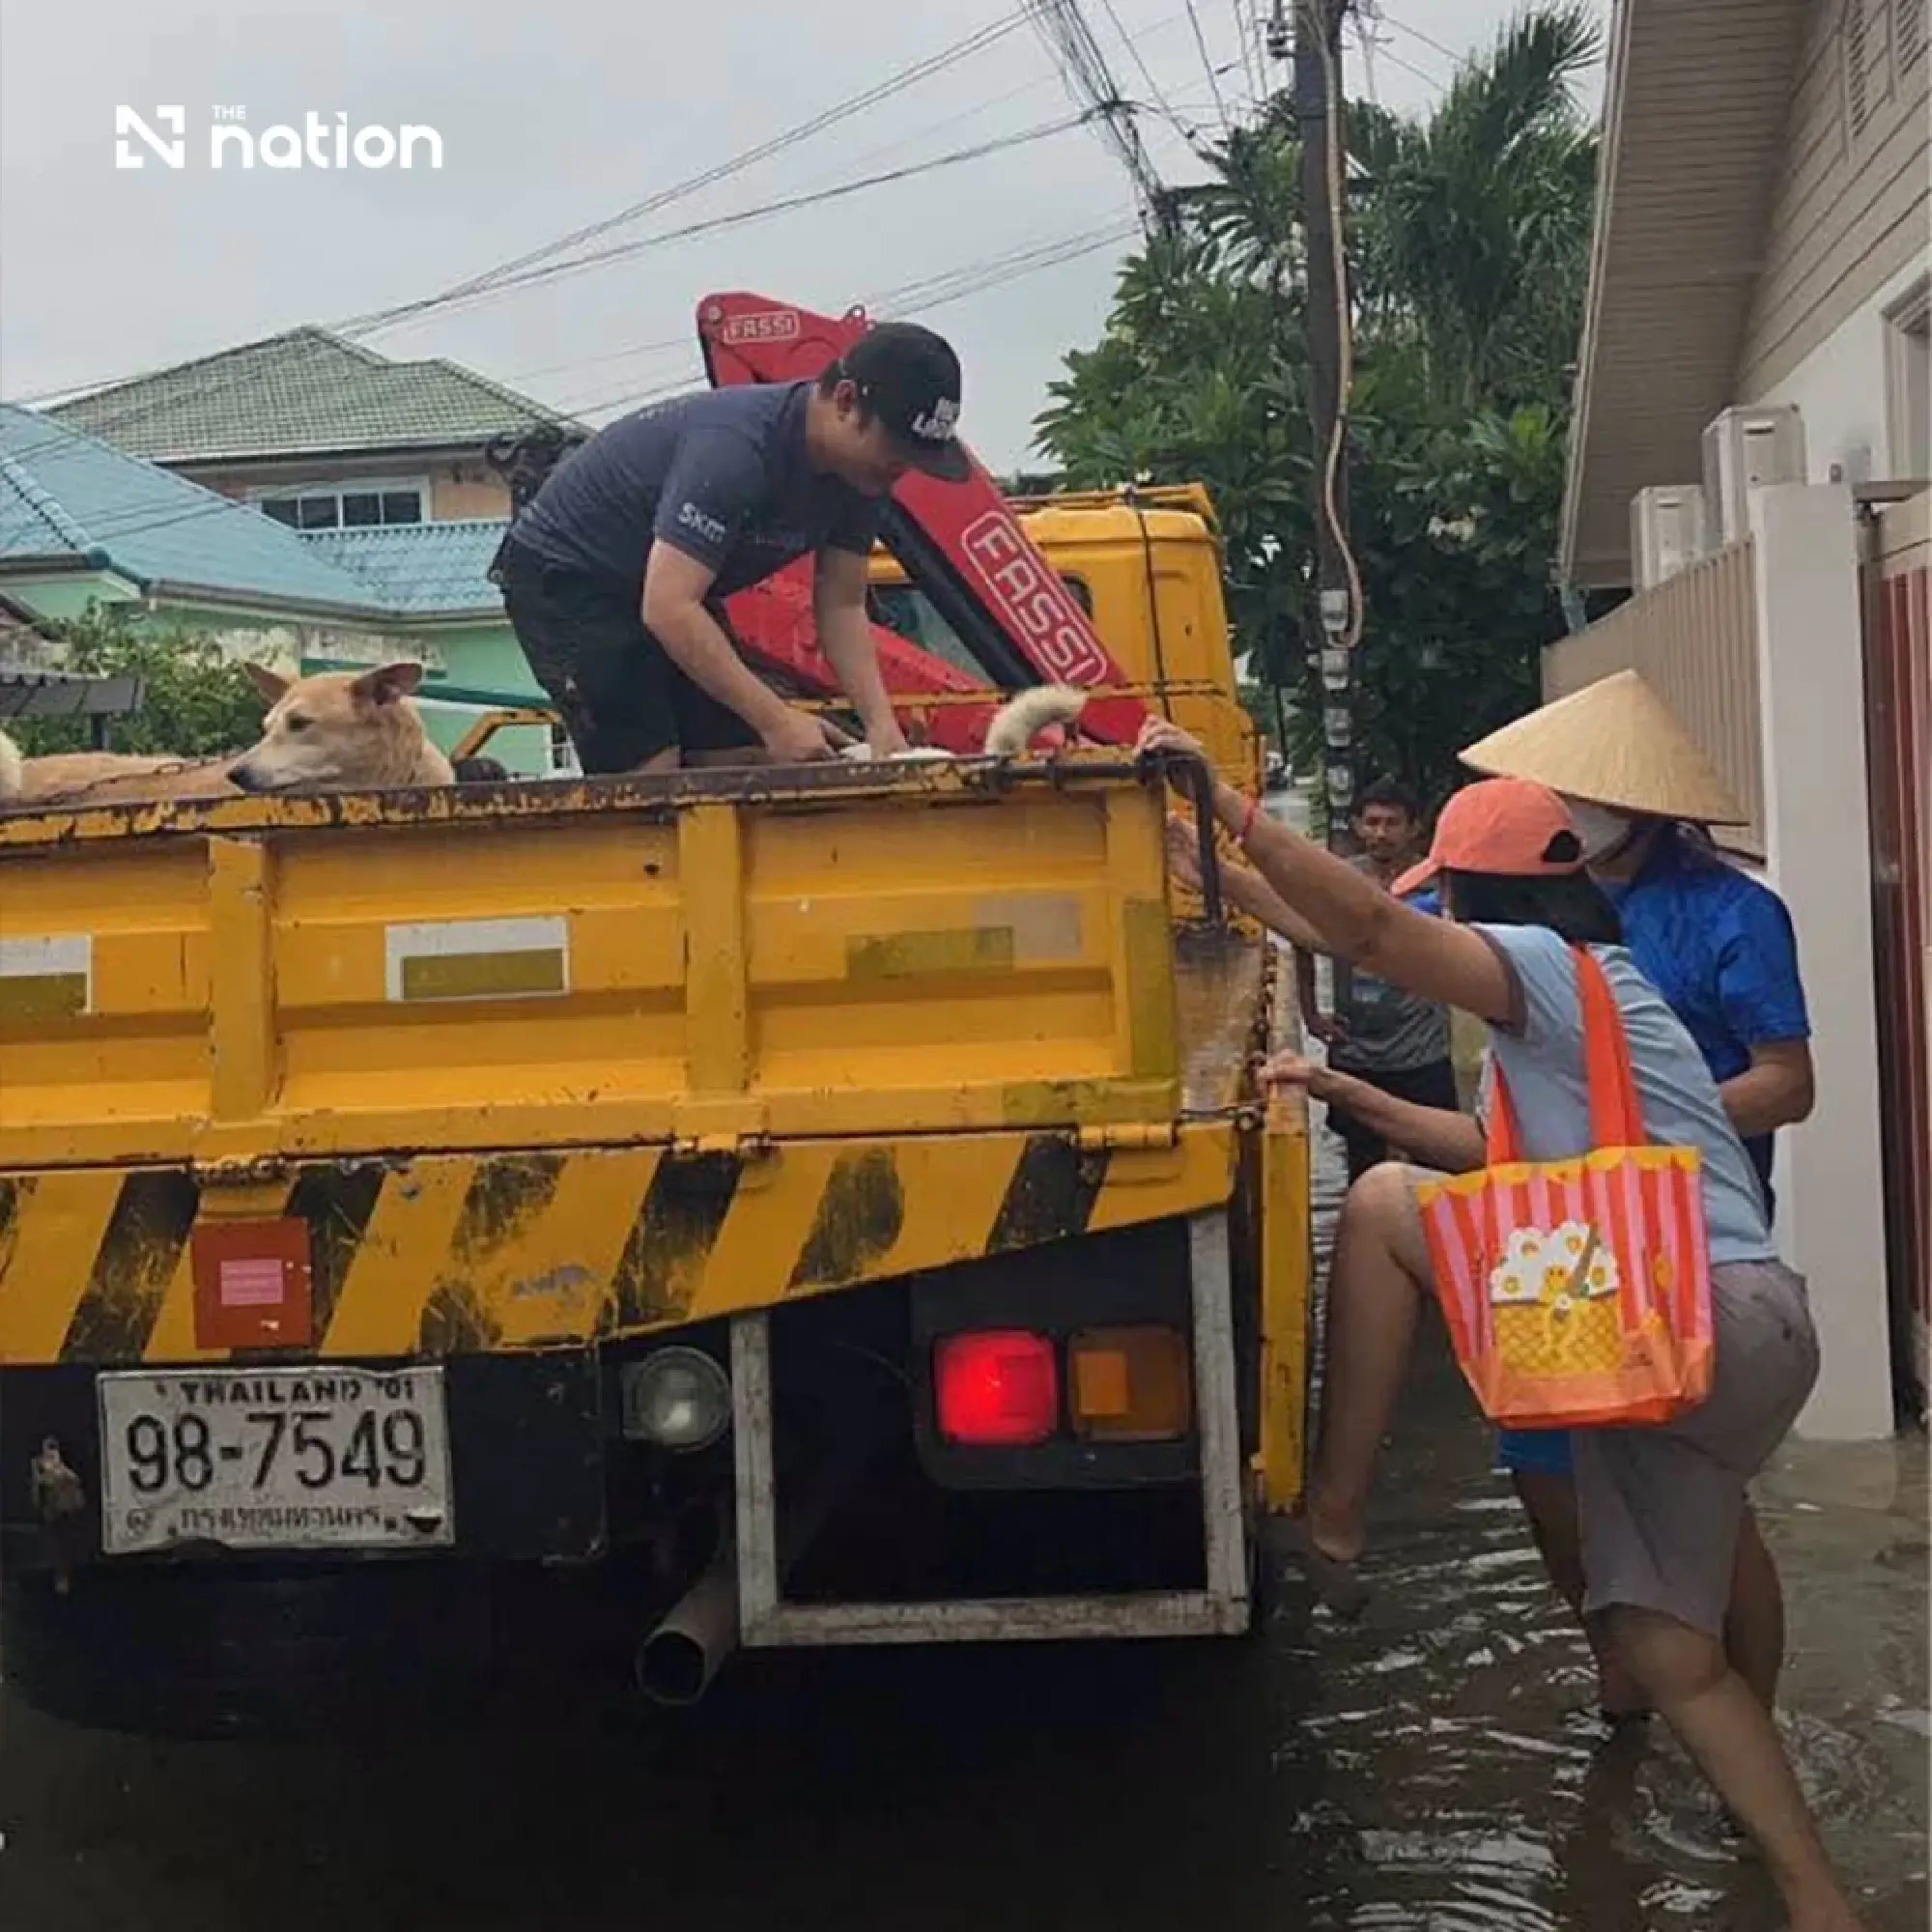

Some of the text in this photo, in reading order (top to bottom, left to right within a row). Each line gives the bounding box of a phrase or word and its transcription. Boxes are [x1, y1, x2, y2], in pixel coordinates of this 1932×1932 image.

[729, 315, 792, 337] FASSI
[973, 526, 1095, 679] FASSI
[180, 1378, 361, 1405] THAILAND
[127, 1408, 425, 1492] 98-7549
